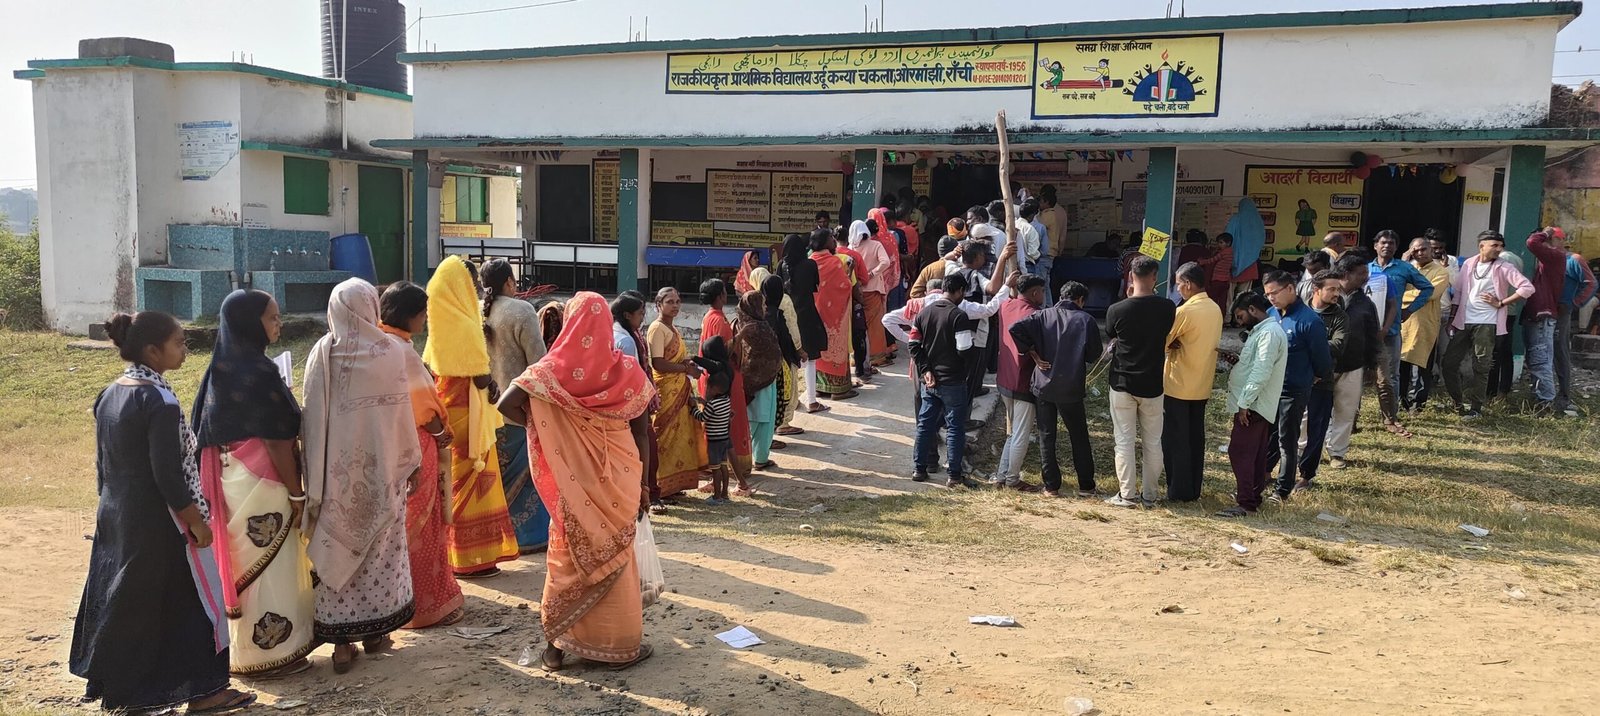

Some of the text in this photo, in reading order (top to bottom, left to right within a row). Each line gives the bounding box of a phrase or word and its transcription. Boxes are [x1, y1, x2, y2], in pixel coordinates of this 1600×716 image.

[353, 6, 378, 14] INTEX
[1075, 40, 1153, 53] समग्र शिक्षा अभियान
[671, 68, 730, 90] राजकीयकृत
[731, 68, 771, 87] प्राथमिक
[772, 67, 812, 86] विद्यालय
[812, 65, 829, 89] उर्दू
[827, 70, 857, 85] कन्या
[946, 58, 975, 83] राँची
[1260, 169, 1303, 186] आदर्श
